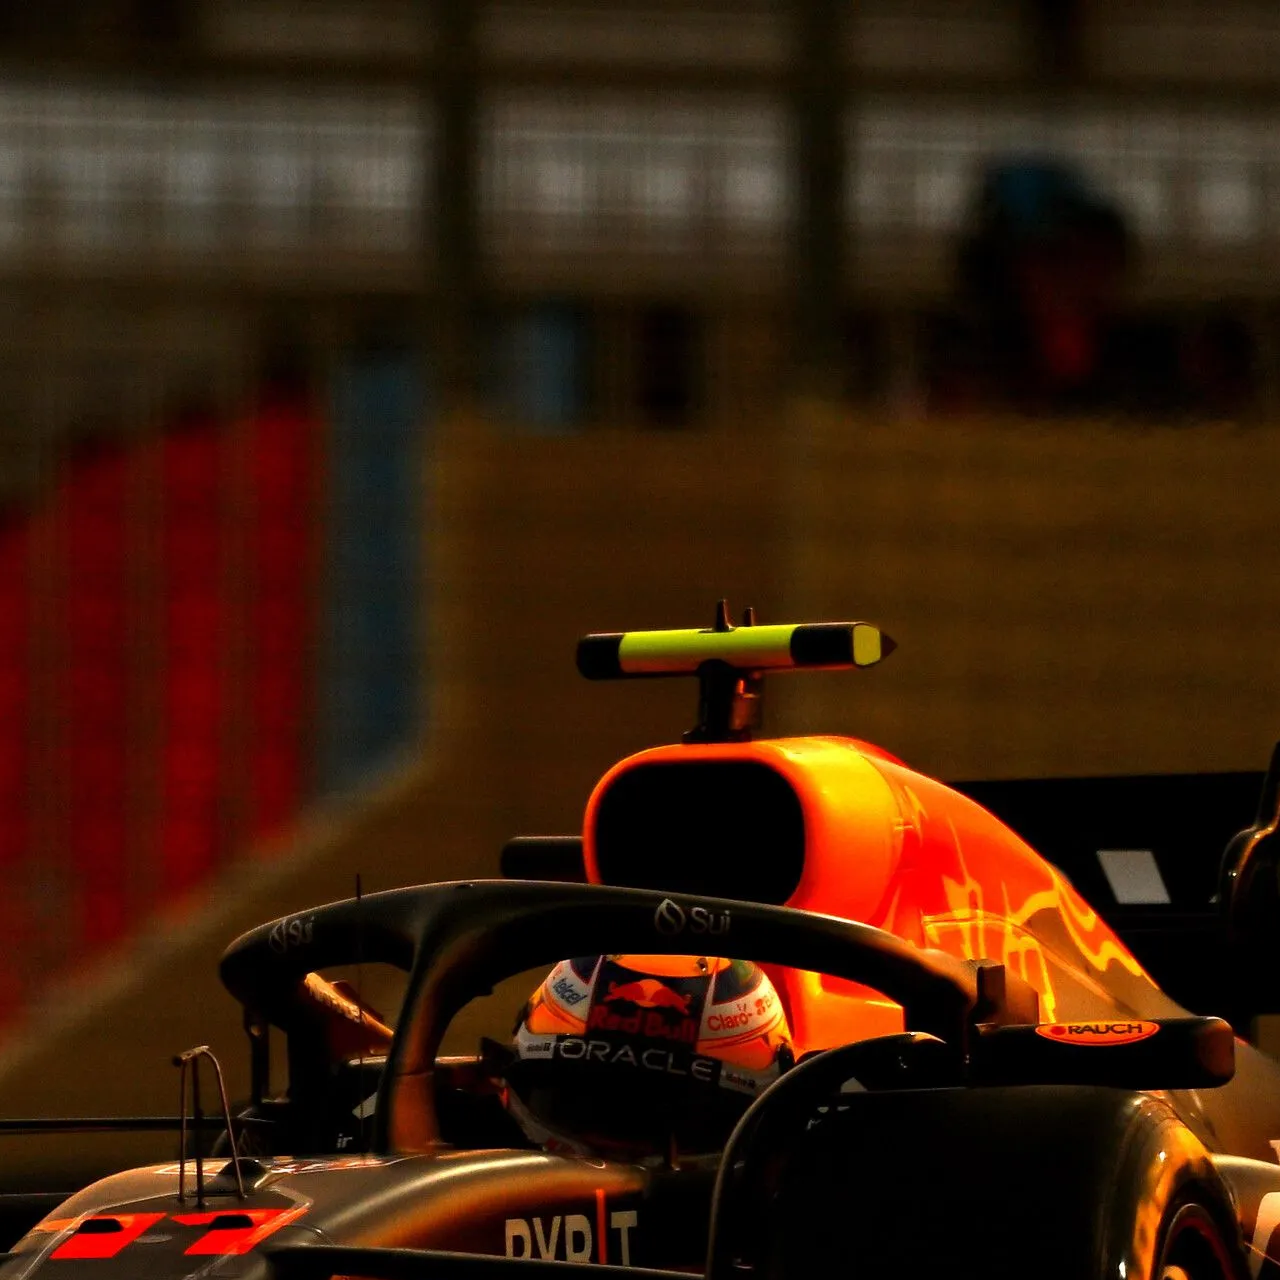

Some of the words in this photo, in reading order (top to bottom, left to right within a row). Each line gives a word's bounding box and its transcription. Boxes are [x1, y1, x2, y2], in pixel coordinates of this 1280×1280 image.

[690, 907, 731, 936] Sui
[588, 1005, 642, 1034] Red
[708, 1011, 749, 1031] Claro
[1068, 1023, 1143, 1035] RAUCH
[558, 1038, 715, 1082] ORACLE
